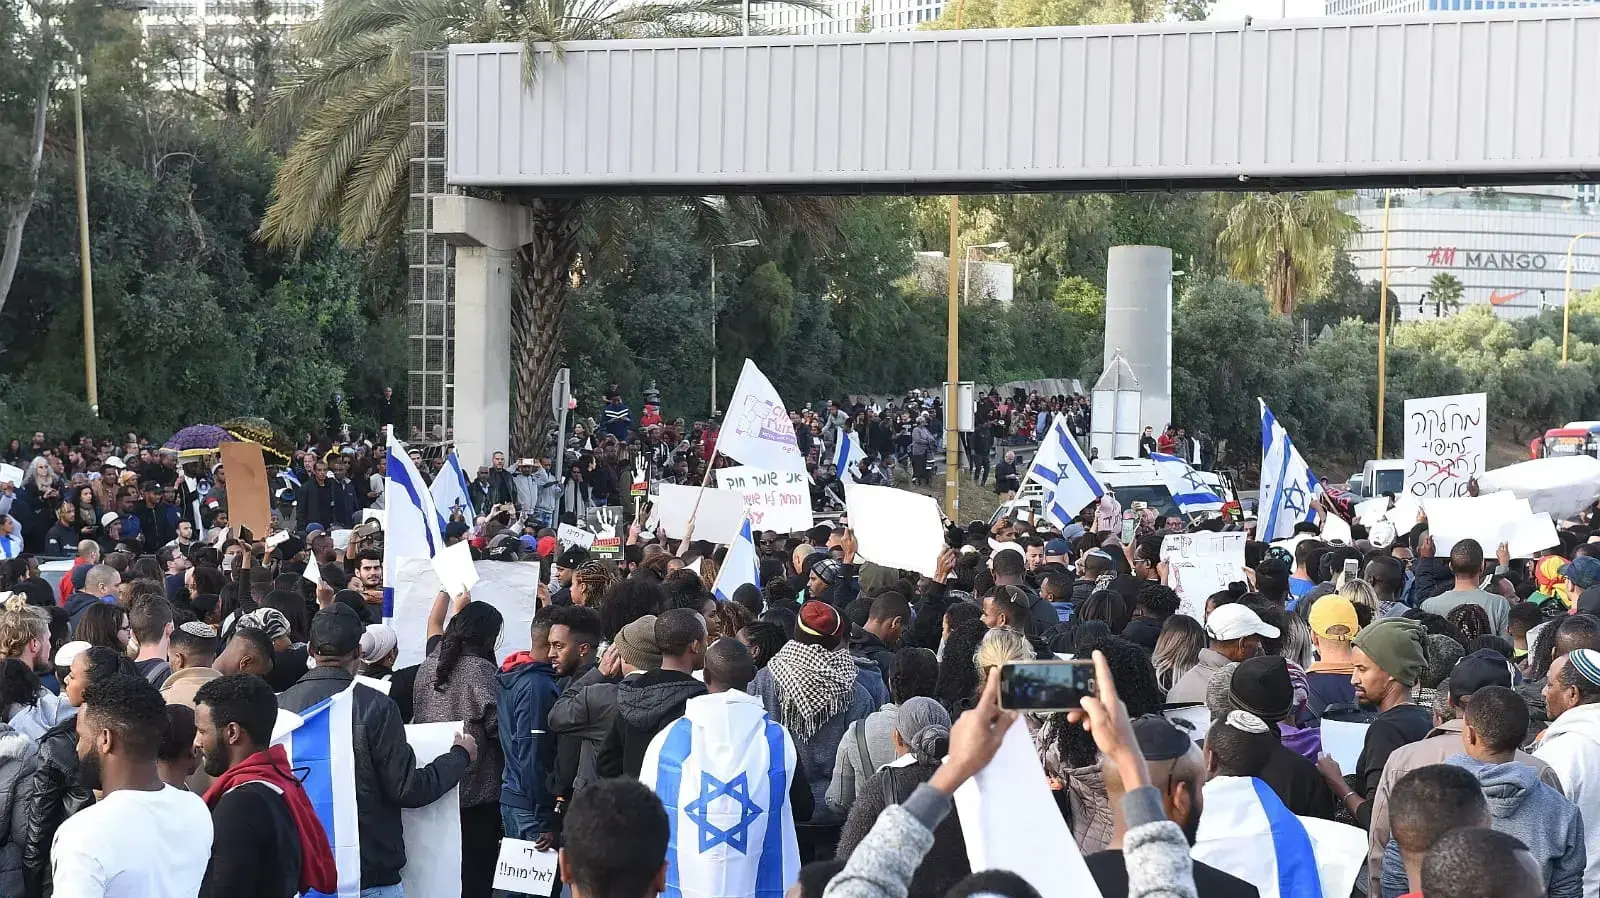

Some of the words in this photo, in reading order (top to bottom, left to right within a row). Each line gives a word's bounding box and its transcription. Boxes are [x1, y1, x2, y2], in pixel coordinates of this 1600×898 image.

[1427, 246, 1457, 266] H&M
[1466, 252, 1547, 270] MANGO
[1411, 403, 1480, 440] מחלקה
[1421, 436, 1472, 456] לחיפוי
[726, 477, 746, 490] חוק
[752, 471, 778, 487] שומר
[786, 472, 803, 483] אני
[523, 847, 534, 859] די
[499, 861, 553, 882] לאלימות!!
